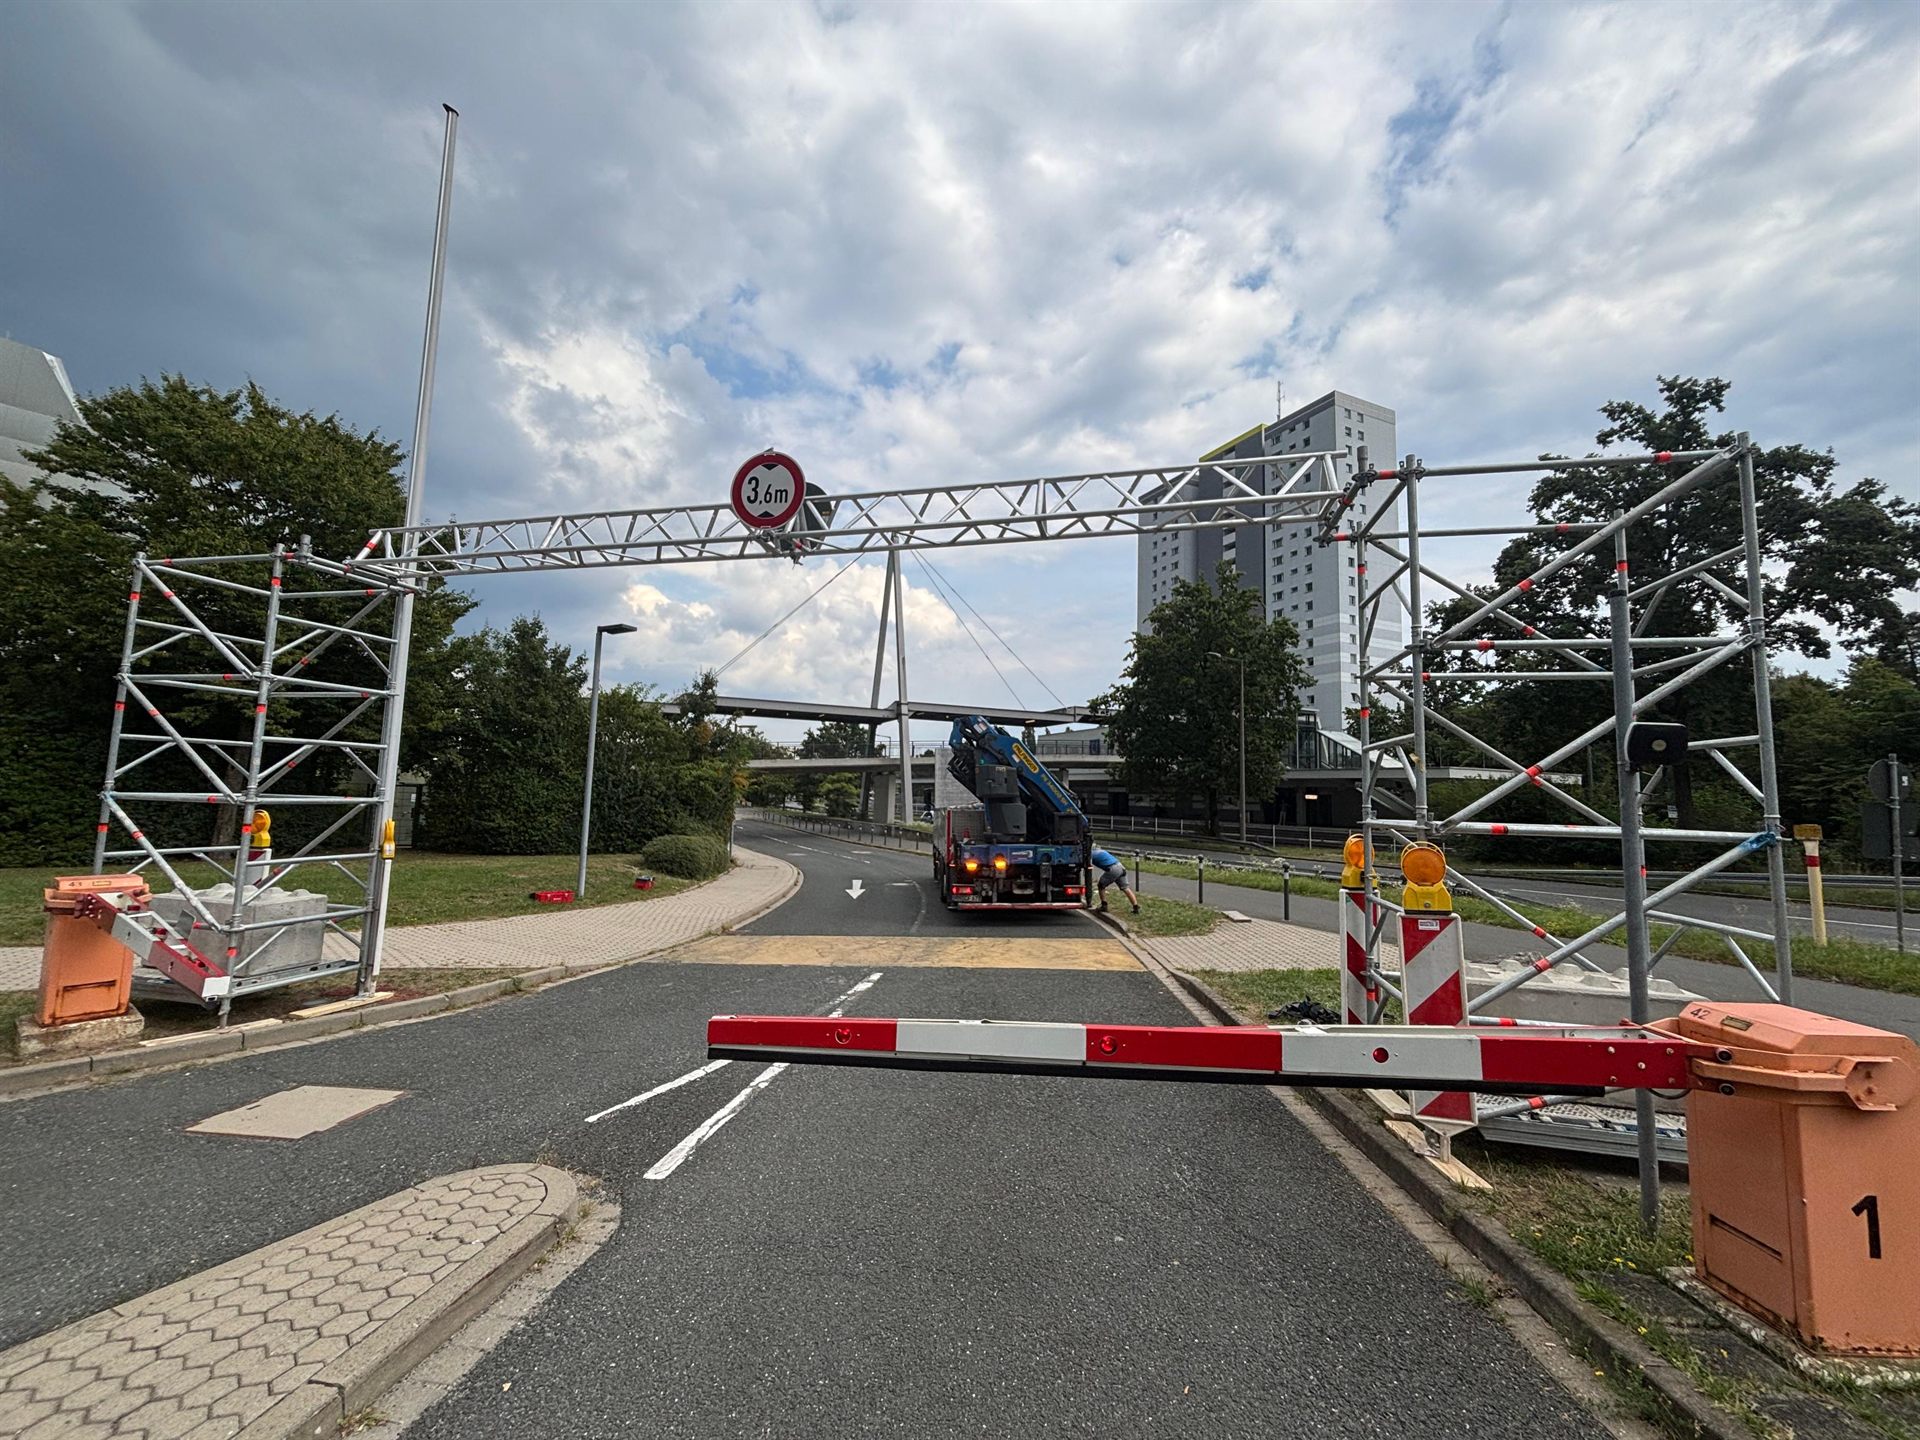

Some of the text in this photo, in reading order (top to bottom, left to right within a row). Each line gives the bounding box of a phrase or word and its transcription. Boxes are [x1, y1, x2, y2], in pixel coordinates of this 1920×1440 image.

[746, 476, 789, 505] 3,6m
[1013, 744, 1038, 772] PALFINGER
[1690, 1008, 1712, 1020] 42
[1851, 1195, 1882, 1259] 1
